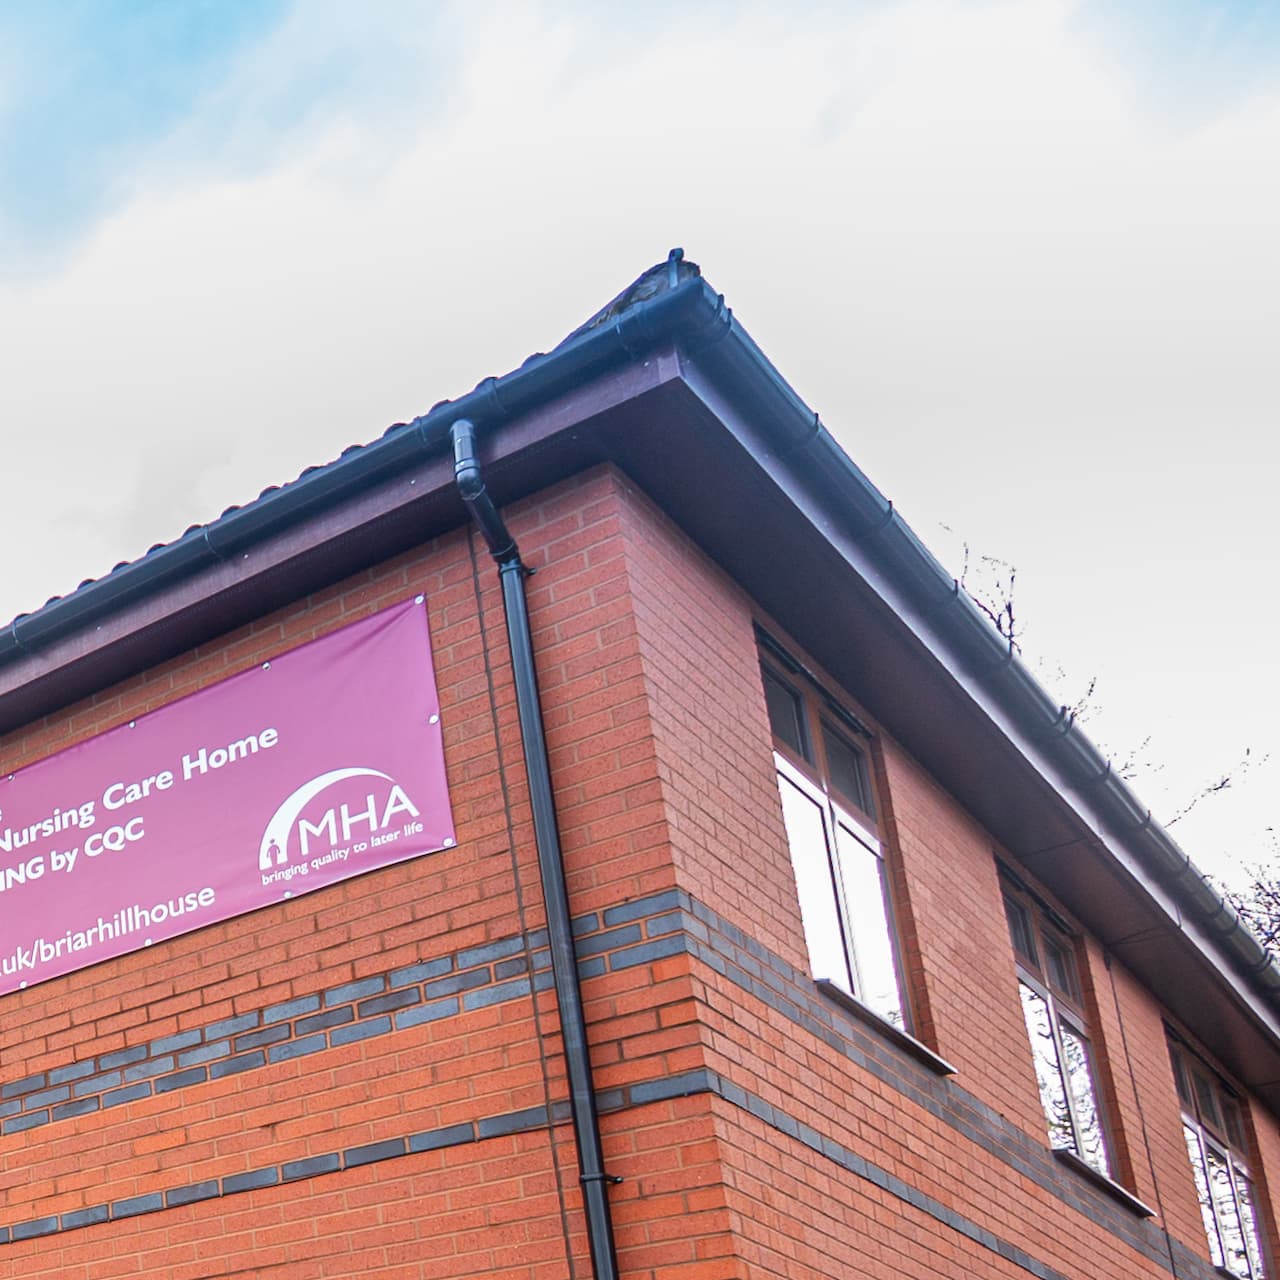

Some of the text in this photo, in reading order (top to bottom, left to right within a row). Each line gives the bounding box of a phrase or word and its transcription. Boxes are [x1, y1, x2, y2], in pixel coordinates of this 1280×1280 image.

[102, 771, 173, 810] Care
[182, 728, 278, 780] Home
[50, 848, 78, 873] by
[84, 817, 145, 857] CQC
[262, 821, 424, 886] bringing quality to later life
[298, 785, 420, 856] MHA
